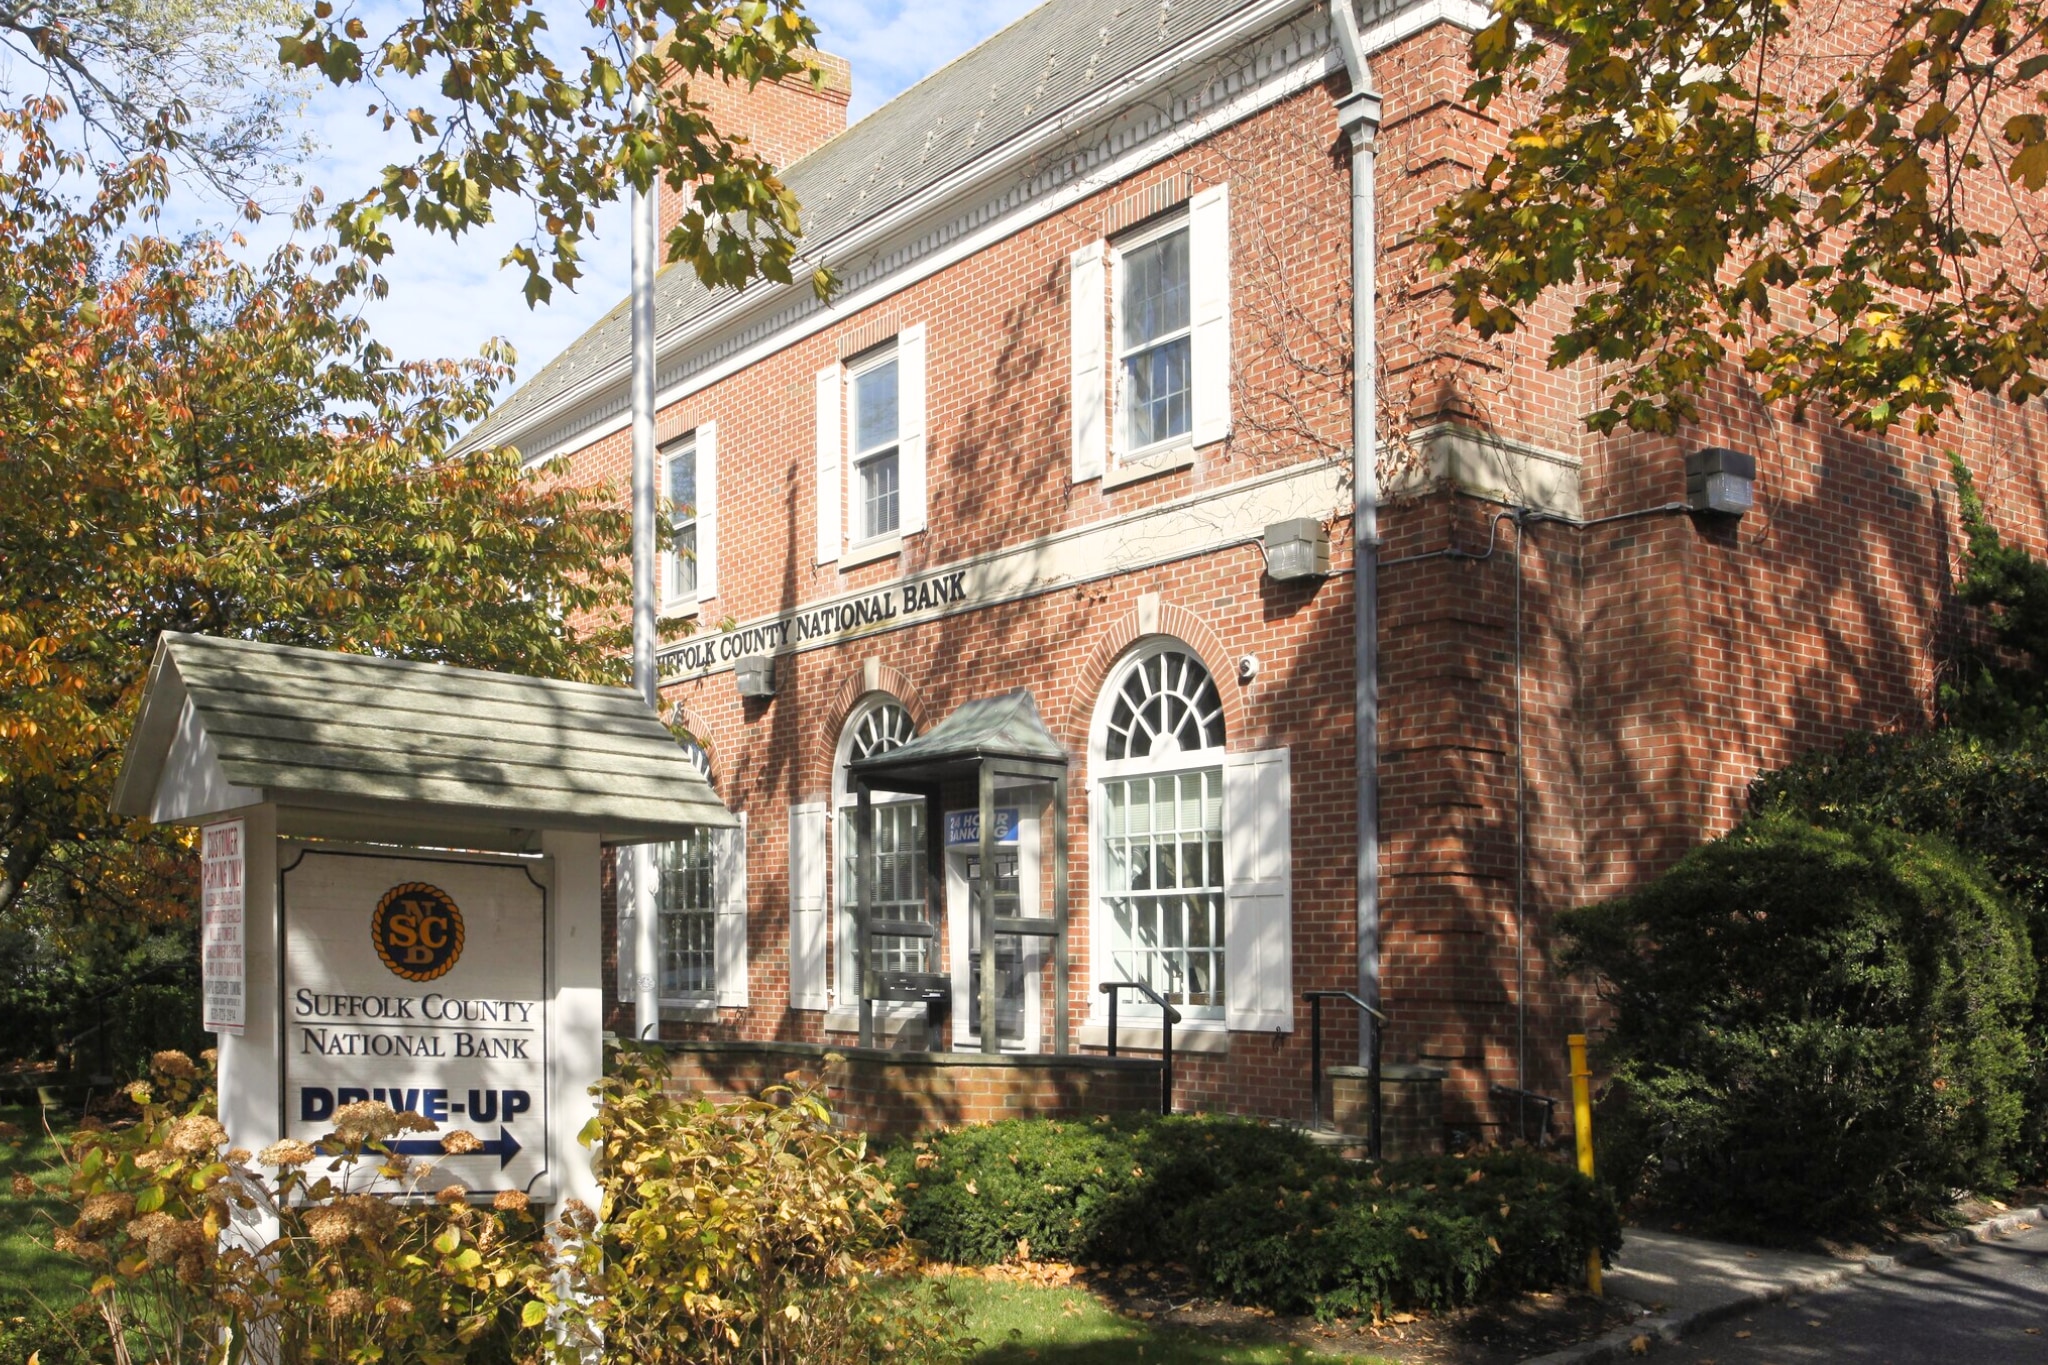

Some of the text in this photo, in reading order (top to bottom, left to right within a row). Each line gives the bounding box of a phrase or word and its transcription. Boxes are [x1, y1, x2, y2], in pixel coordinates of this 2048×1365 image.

[656, 571, 967, 677] UFFOLK COUNTY NATIONAL BANK
[963, 812, 1009, 829] HOR
[296, 988, 534, 1023] SUFFOLK COUNTY
[302, 1028, 530, 1060] NATIONAL BANK
